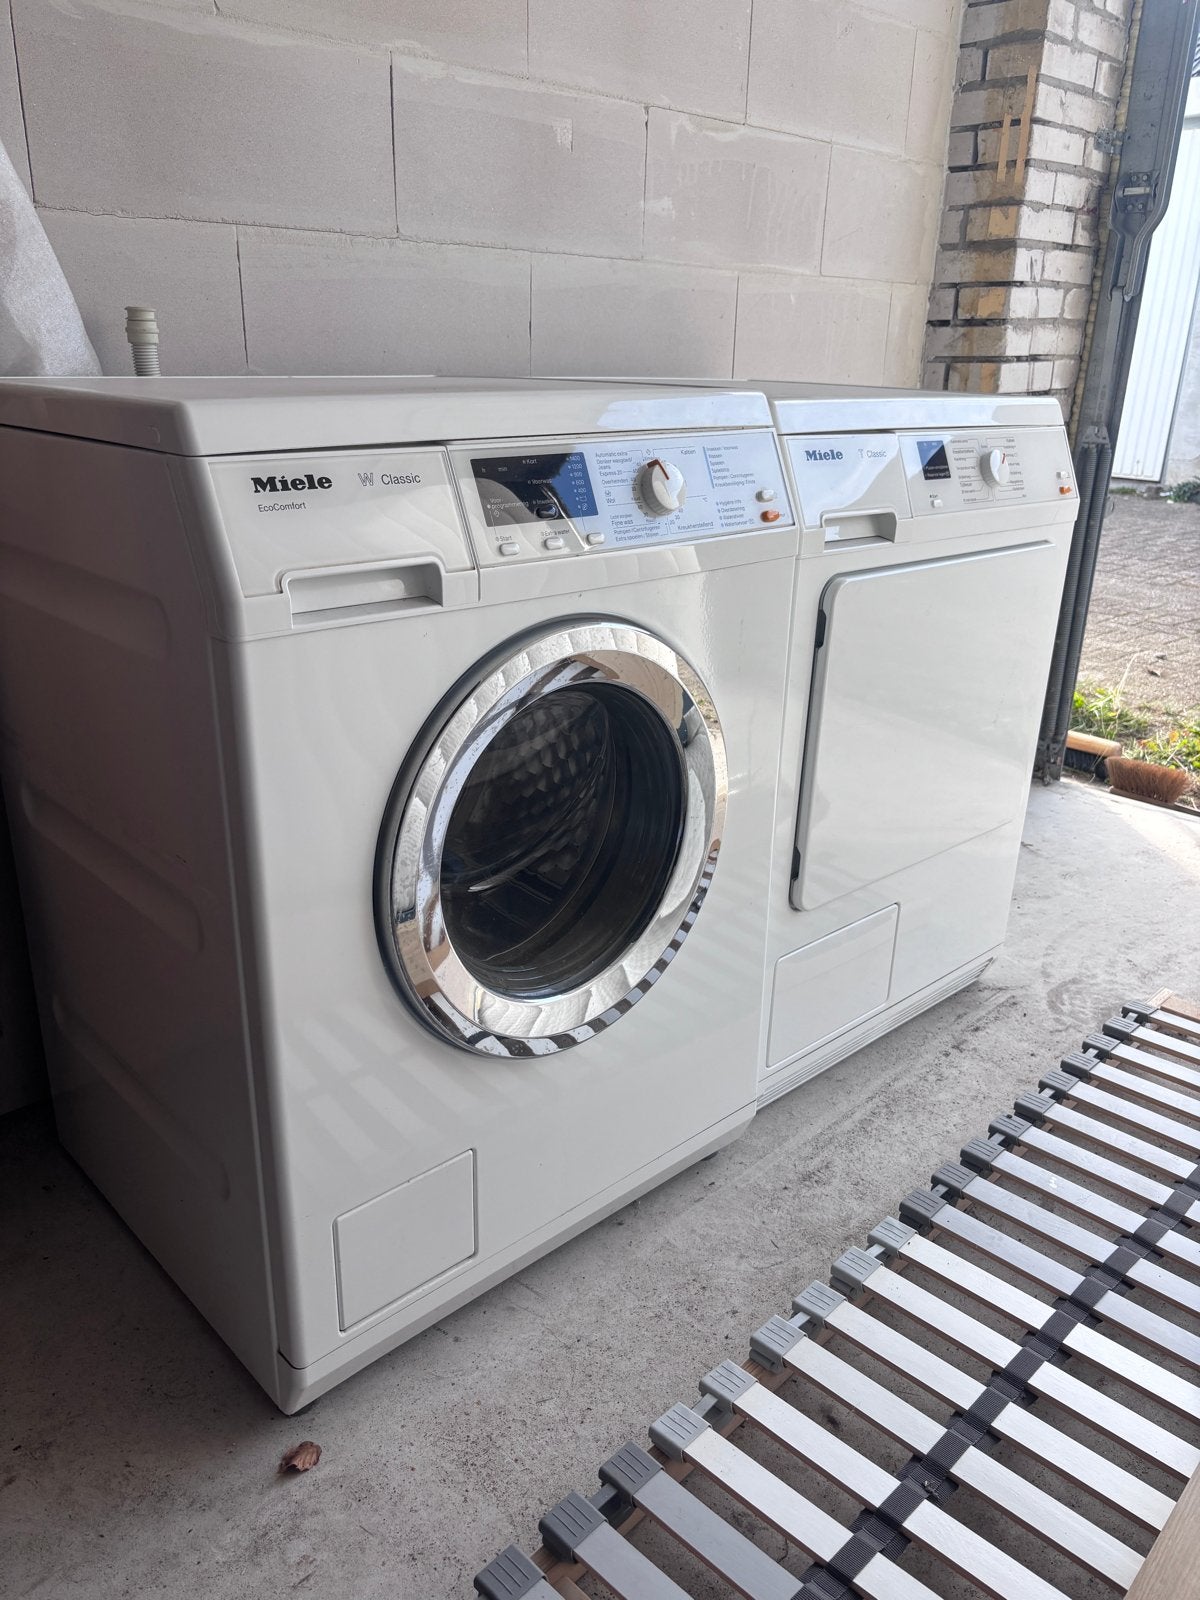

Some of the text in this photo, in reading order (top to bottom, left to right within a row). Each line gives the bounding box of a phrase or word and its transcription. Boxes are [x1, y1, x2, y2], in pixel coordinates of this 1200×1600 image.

[805, 449, 844, 461] Miele
[251, 474, 333, 493] Miele
[358, 473, 421, 486] W Classic
[258, 502, 306, 513] EcoComfort
